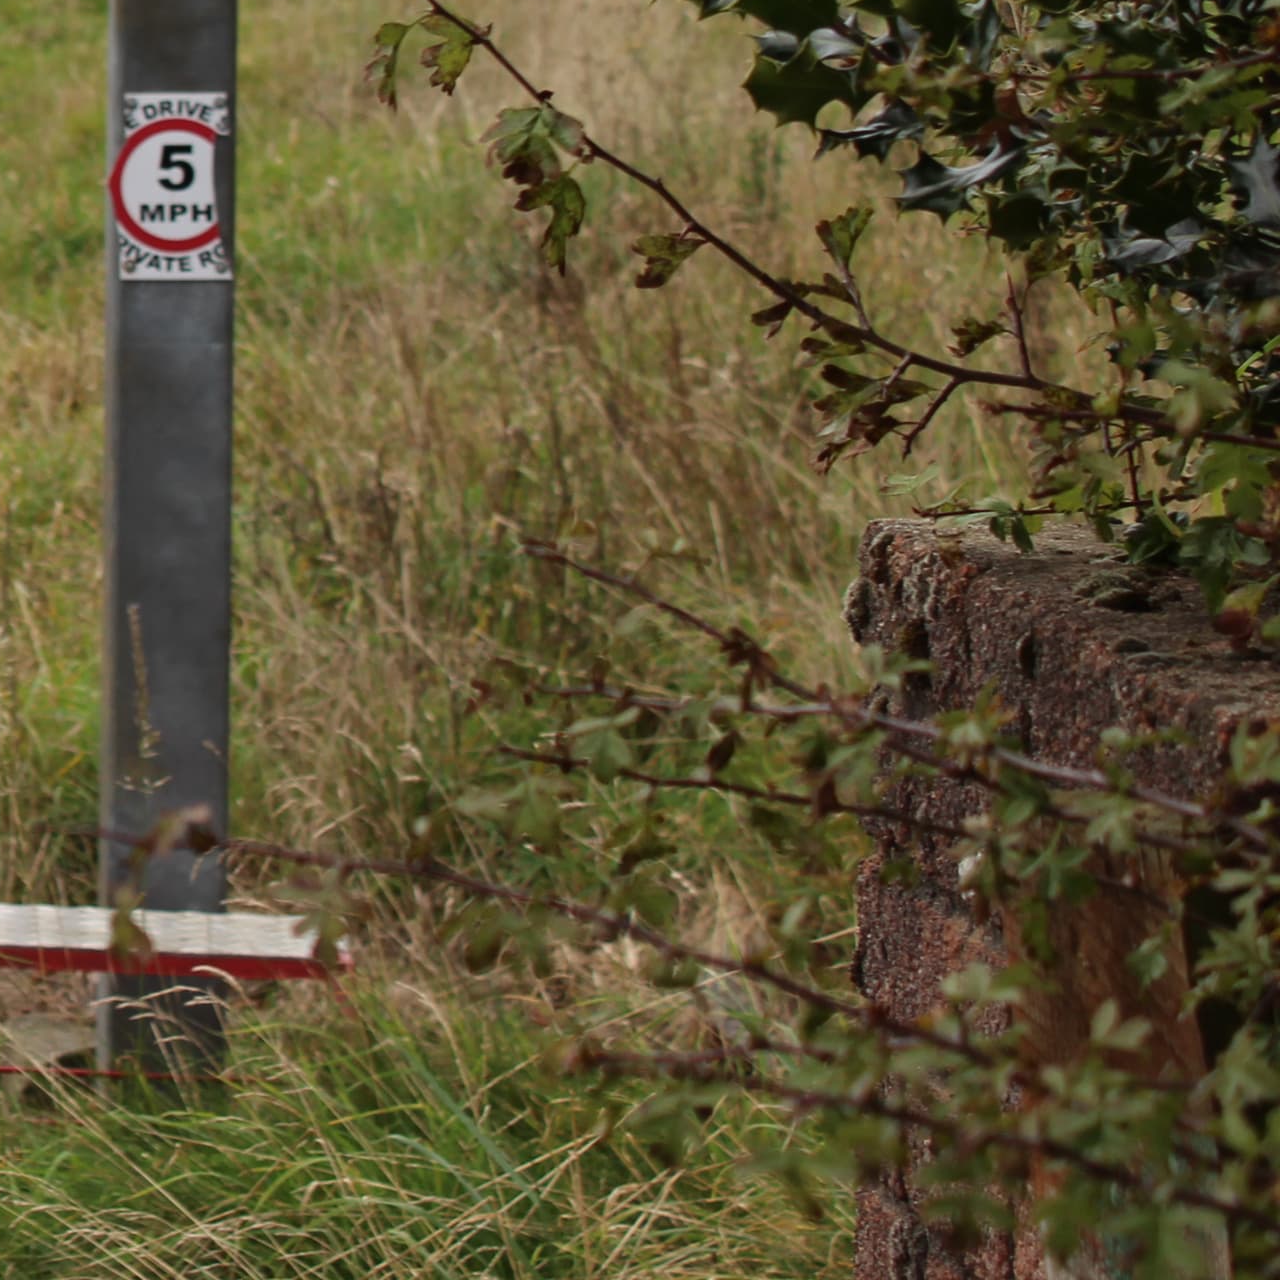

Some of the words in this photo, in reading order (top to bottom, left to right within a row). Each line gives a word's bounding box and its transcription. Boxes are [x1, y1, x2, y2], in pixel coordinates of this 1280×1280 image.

[143, 100, 213, 122] DRIVE
[158, 145, 195, 191] 5
[140, 204, 213, 223] MPH
